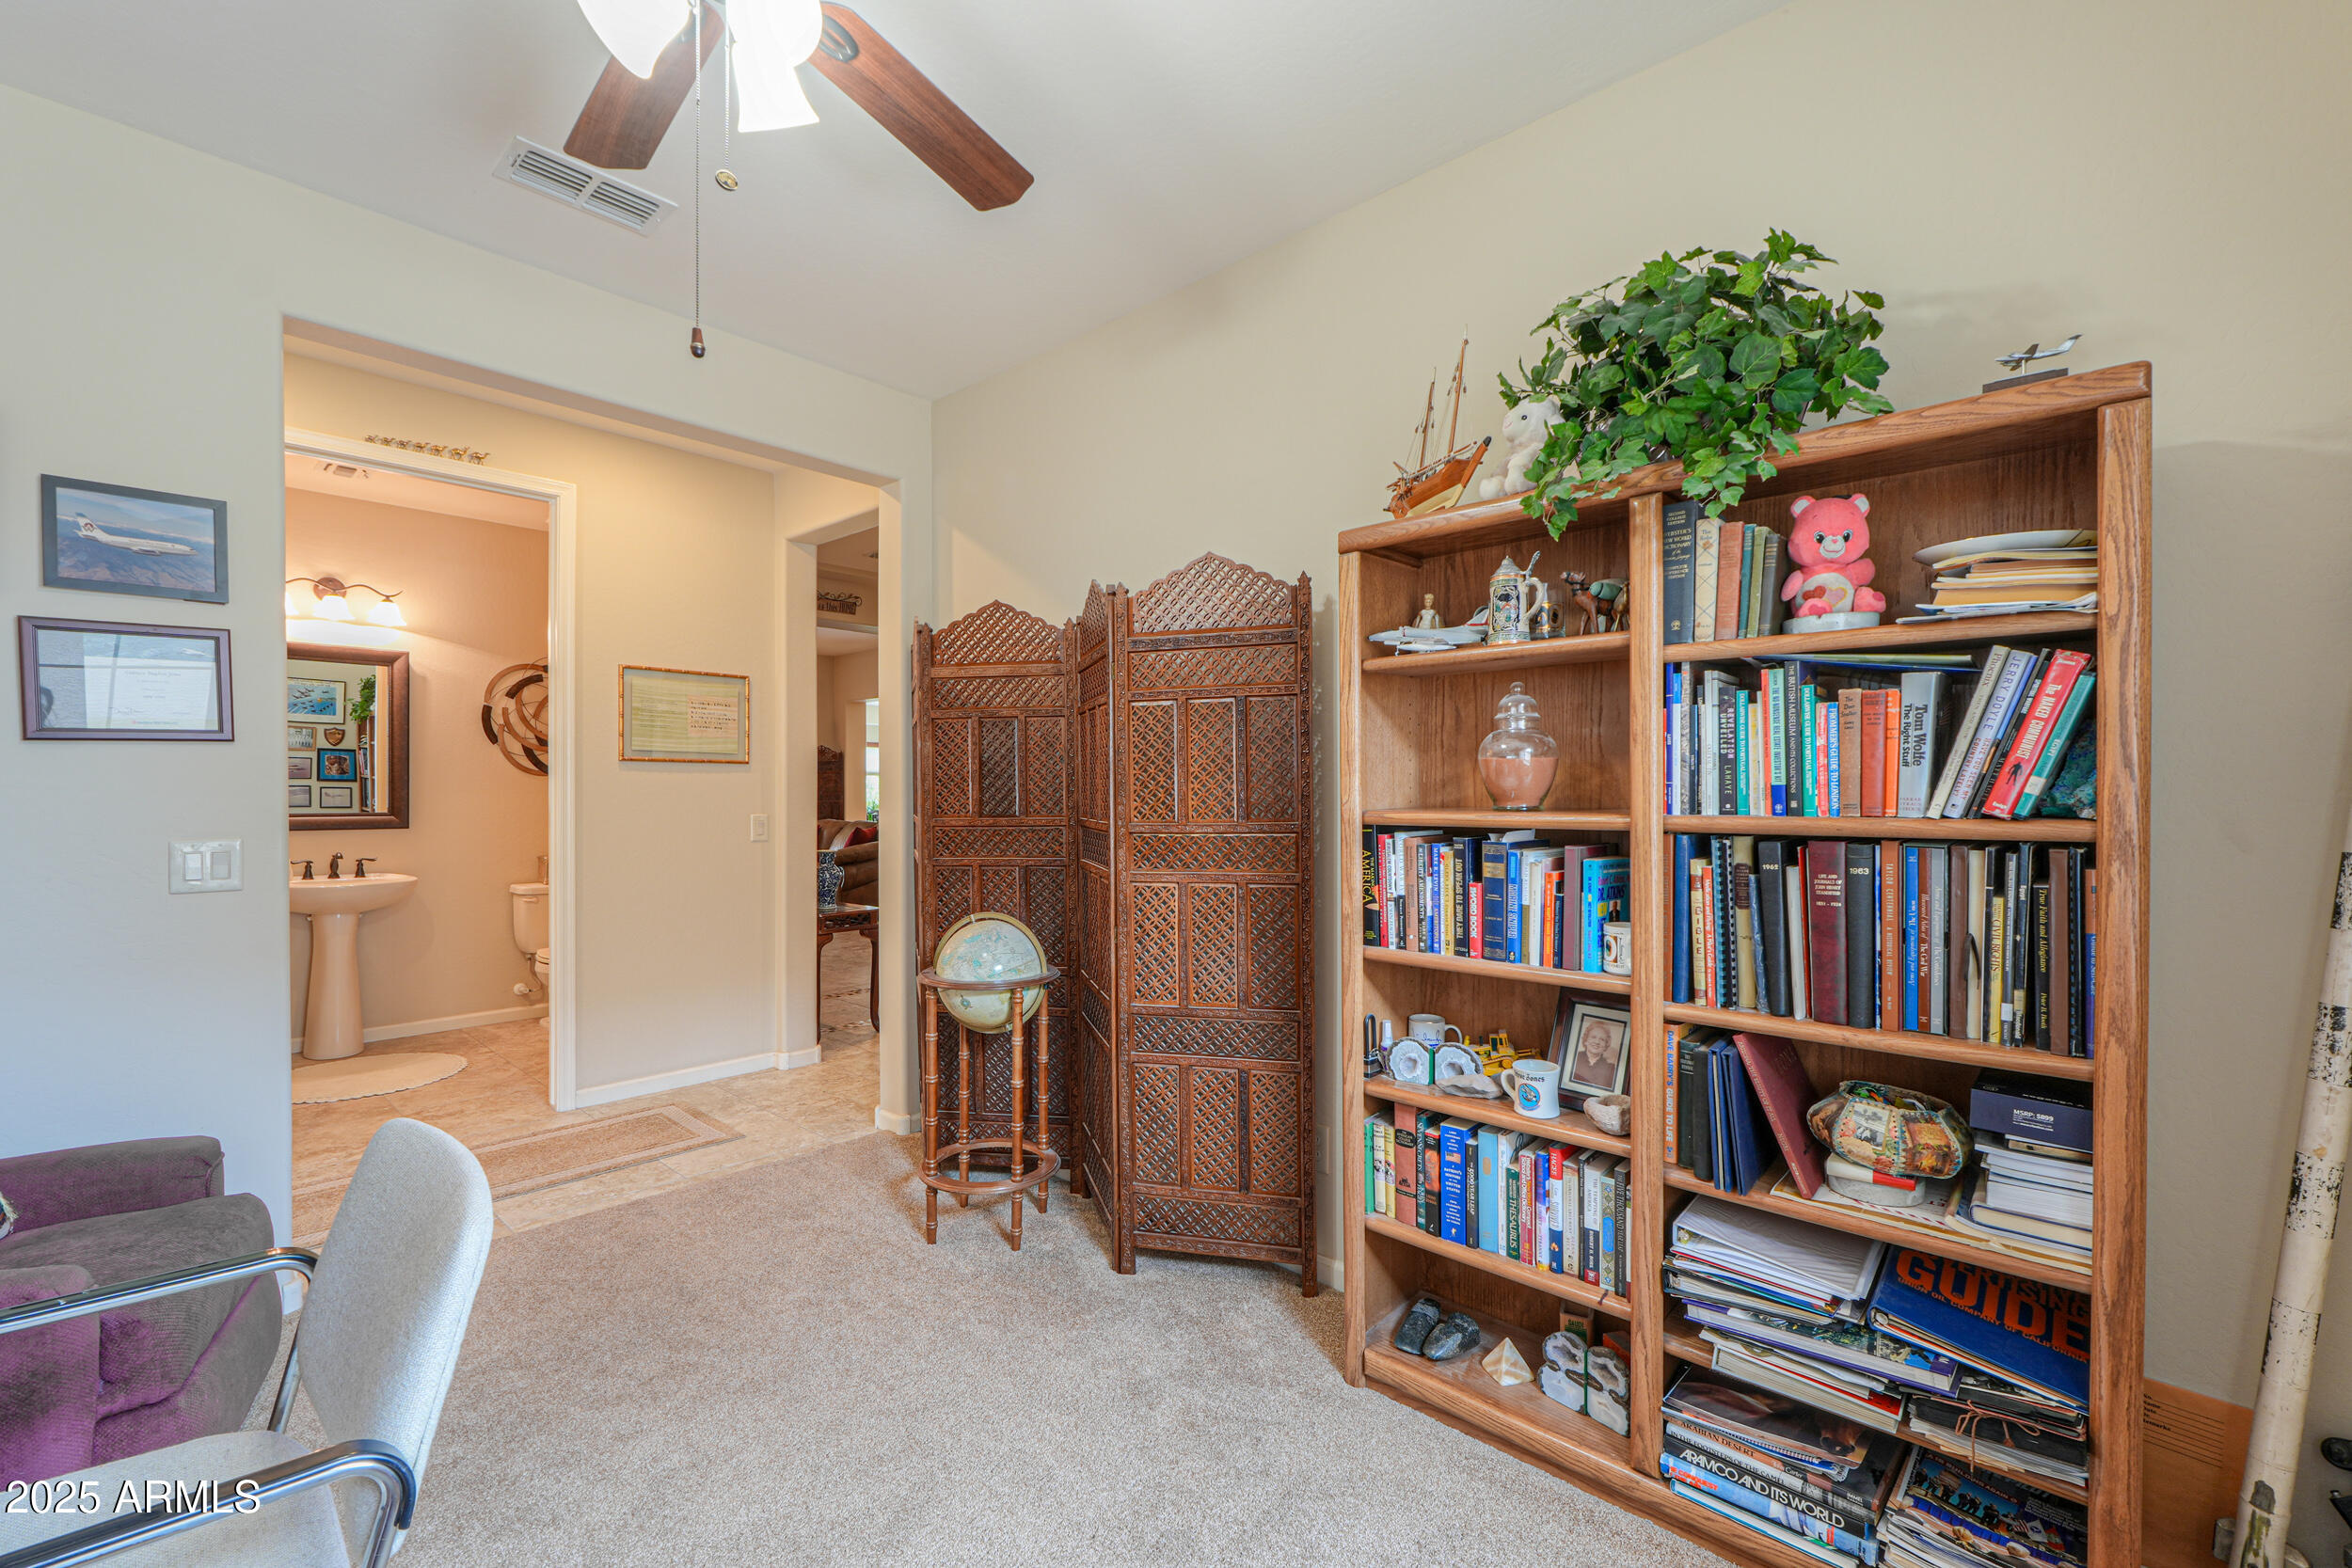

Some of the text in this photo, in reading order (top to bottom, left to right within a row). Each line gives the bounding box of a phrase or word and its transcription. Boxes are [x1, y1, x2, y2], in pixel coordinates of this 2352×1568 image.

[1981, 653, 2003, 688] Phoenix
[1788, 676, 1797, 702] BRITISH
[1983, 656, 2022, 731] JERRY DOYLE
[1720, 713, 1728, 754] UNVEILED
[1773, 725, 1783, 736] REAL
[1789, 704, 1798, 736] MUSEUM
[2015, 684, 2062, 760] The NAKED COMMUNIST
[1901, 704, 1913, 768] The Right Stuff
[1912, 704, 1929, 767] Tom Wolfe
[1829, 708, 1839, 810] FROMMER'S GUIDE TO LONDON
[1950, 737, 1982, 798] COUNTRY LATELY?
[1961, 737, 1993, 800] HAVE YOU SEEN MY
[1724, 765, 1732, 795] LAHAYE
[1774, 775, 1784, 784] KIT
[1362, 849, 1373, 904] AMERICA
[1454, 859, 1463, 872] OUT
[1885, 863, 1894, 885] TAYLOR
[1454, 873, 1463, 894] SPEAK
[2019, 885, 2027, 900] Egypt
[1454, 895, 1463, 904] TO
[1470, 892, 1478, 915] WORD
[1508, 883, 1518, 939] MARINE SNIPER
[1885, 889, 1894, 921] CENTENNIAL
[1920, 894, 1930, 919] Illustrated
[1455, 923, 1464, 939] THEY
[1907, 917, 1915, 927] The
[1920, 919, 1929, 933] Atlas
[2038, 889, 2048, 973] True Faith and Allegiance
[1919, 942, 1928, 954] The
[1933, 946, 1942, 956] The
[1992, 918, 2001, 972] CIVIL RIGHTS
[1906, 961, 1915, 972] and
[1919, 954, 1928, 965] Civil
[1919, 965, 1928, 977] War
[1906, 973, 1915, 987] Arms
[1666, 1053, 1675, 1085] BARRY'S
[1666, 1114, 1674, 1125] TO
[2013, 1109, 2036, 1119] MSRP:
[1467, 1167, 1475, 1185] 5000
[1509, 1199, 1518, 1248] THESAURUS
[1895, 1249, 2090, 1362] GUIDE
[1897, 1276, 2089, 1364] UNION OIL COMPANY OF CALIFORNIA
[1680, 1420, 1756, 1459] ARABIAN DESERT
[1678, 1432, 1693, 1444] THE
[1692, 1438, 1734, 1463] FOOTSTEPS
[1734, 1458, 1745, 1468] OF
[1744, 1464, 1760, 1474] THE
[1760, 1469, 1787, 1485] CAMEL
[1784, 1466, 1804, 1479] Carter
[1678, 1449, 1845, 1528] ARAMCO AND ITS WORLD
